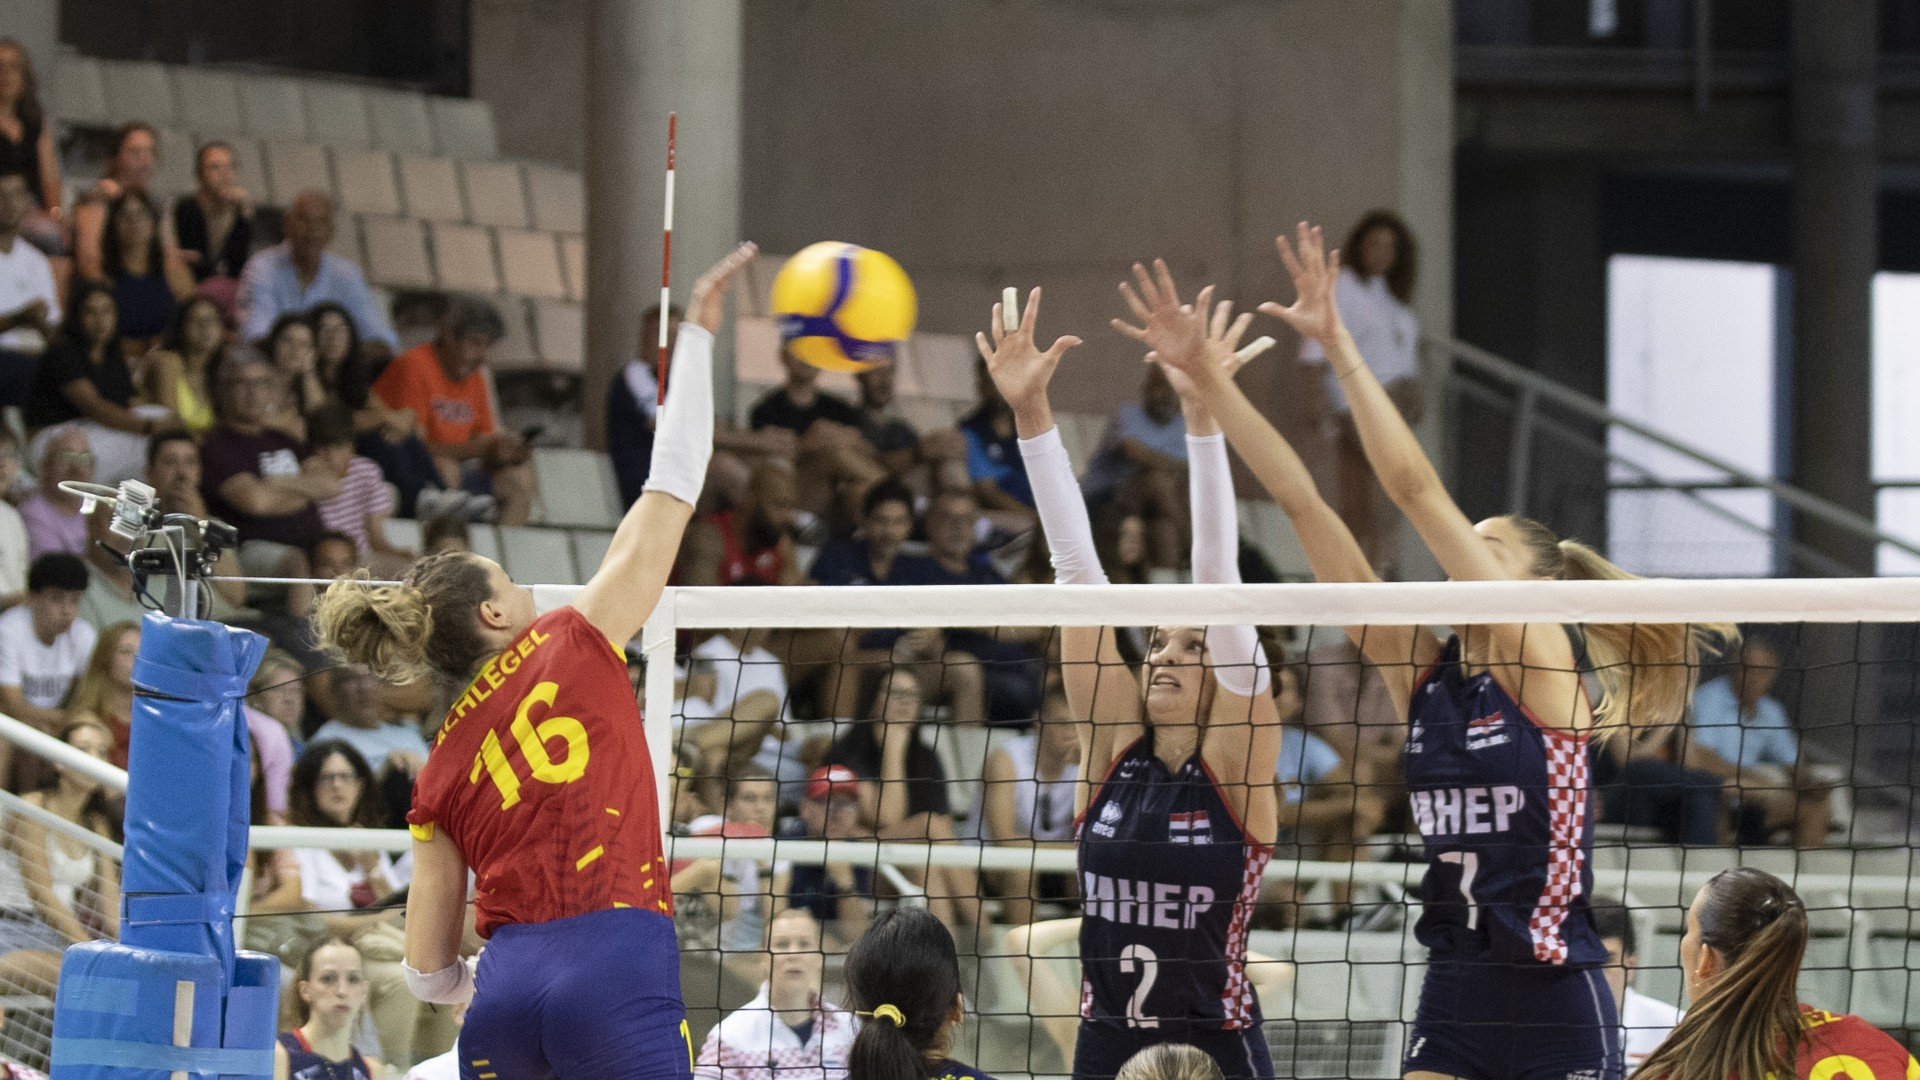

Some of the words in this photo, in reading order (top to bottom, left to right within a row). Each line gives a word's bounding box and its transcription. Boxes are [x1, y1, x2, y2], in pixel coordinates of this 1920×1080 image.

[469, 681, 590, 811] 16
[1437, 851, 1479, 931] 7
[1119, 943, 1159, 1029] 2
